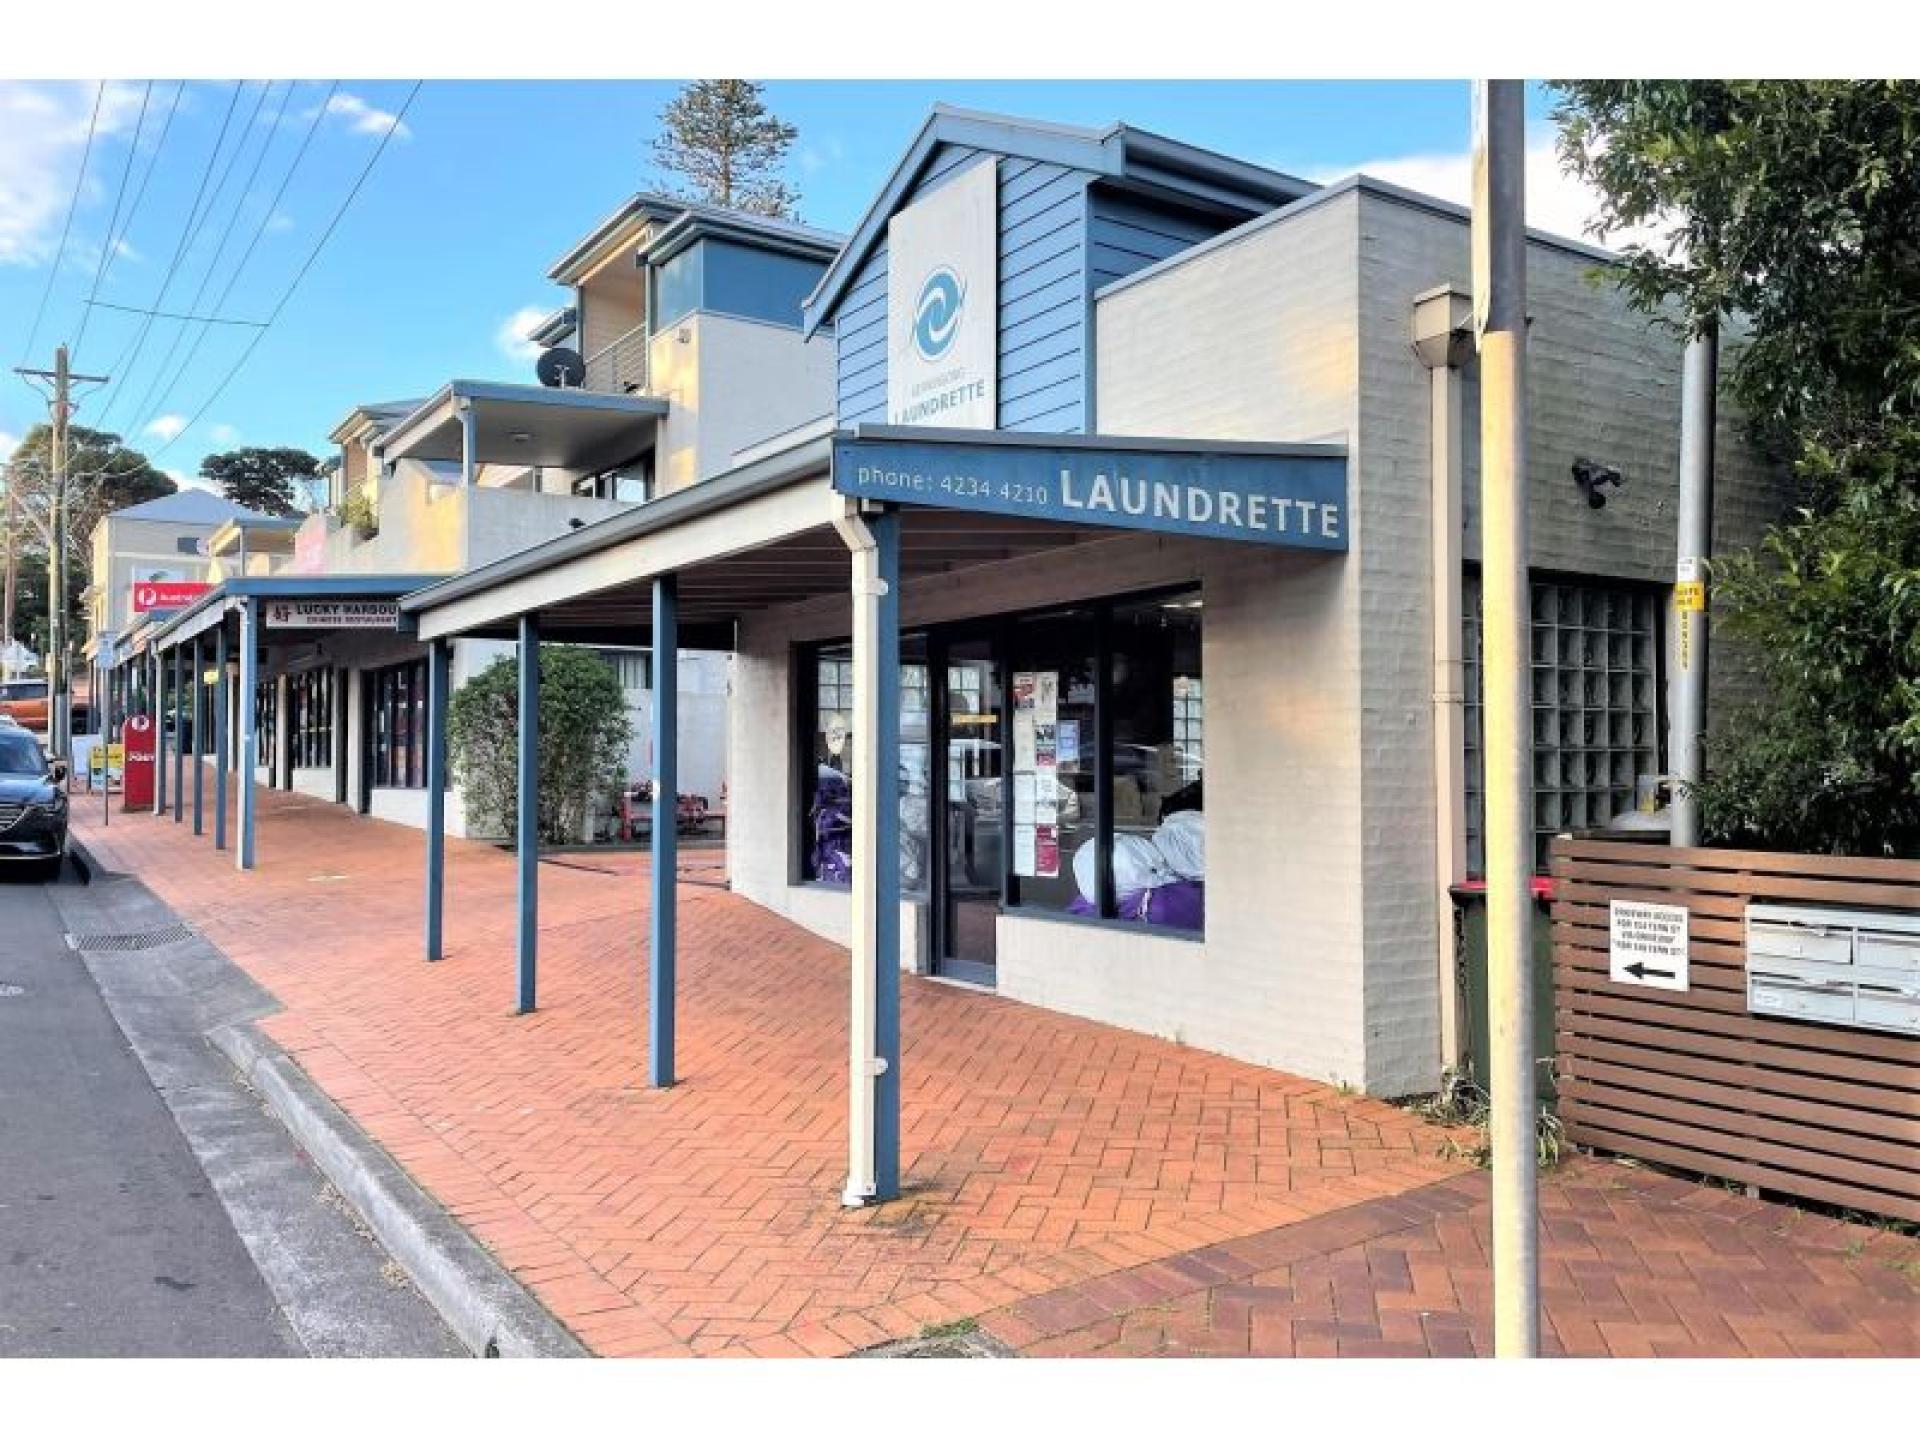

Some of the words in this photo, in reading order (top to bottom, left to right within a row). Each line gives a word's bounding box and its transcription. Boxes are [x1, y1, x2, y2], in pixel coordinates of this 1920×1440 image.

[857, 466, 934, 491] phone:
[940, 476, 990, 497] 4234
[999, 482, 1048, 505] 4210
[1060, 469, 1340, 539] LAUNDRETTE
[296, 603, 339, 615] LUCKY
[342, 603, 397, 615] HARBOU
